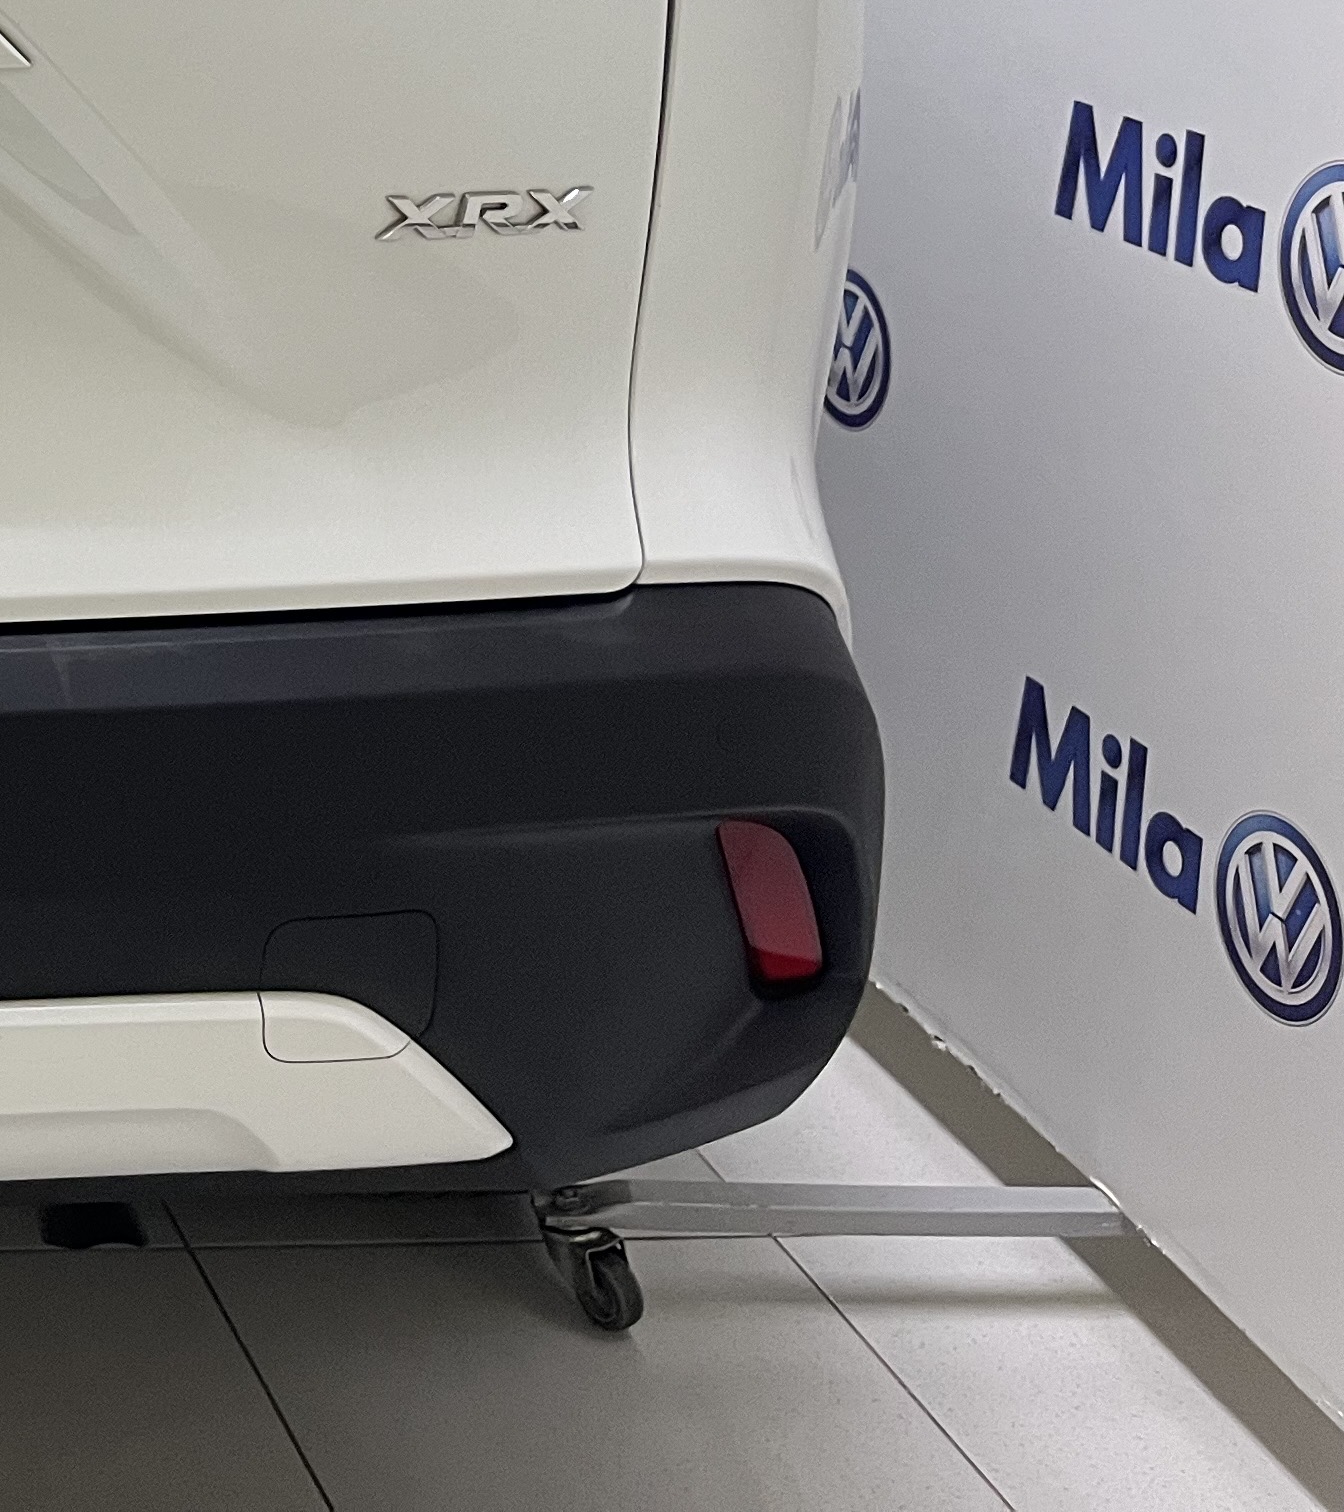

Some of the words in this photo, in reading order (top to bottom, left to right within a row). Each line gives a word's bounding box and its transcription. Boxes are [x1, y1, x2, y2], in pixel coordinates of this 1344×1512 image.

[374, 185, 595, 240] XRX
[1054, 99, 1267, 294] Mila
[1009, 675, 1205, 916] Mila
